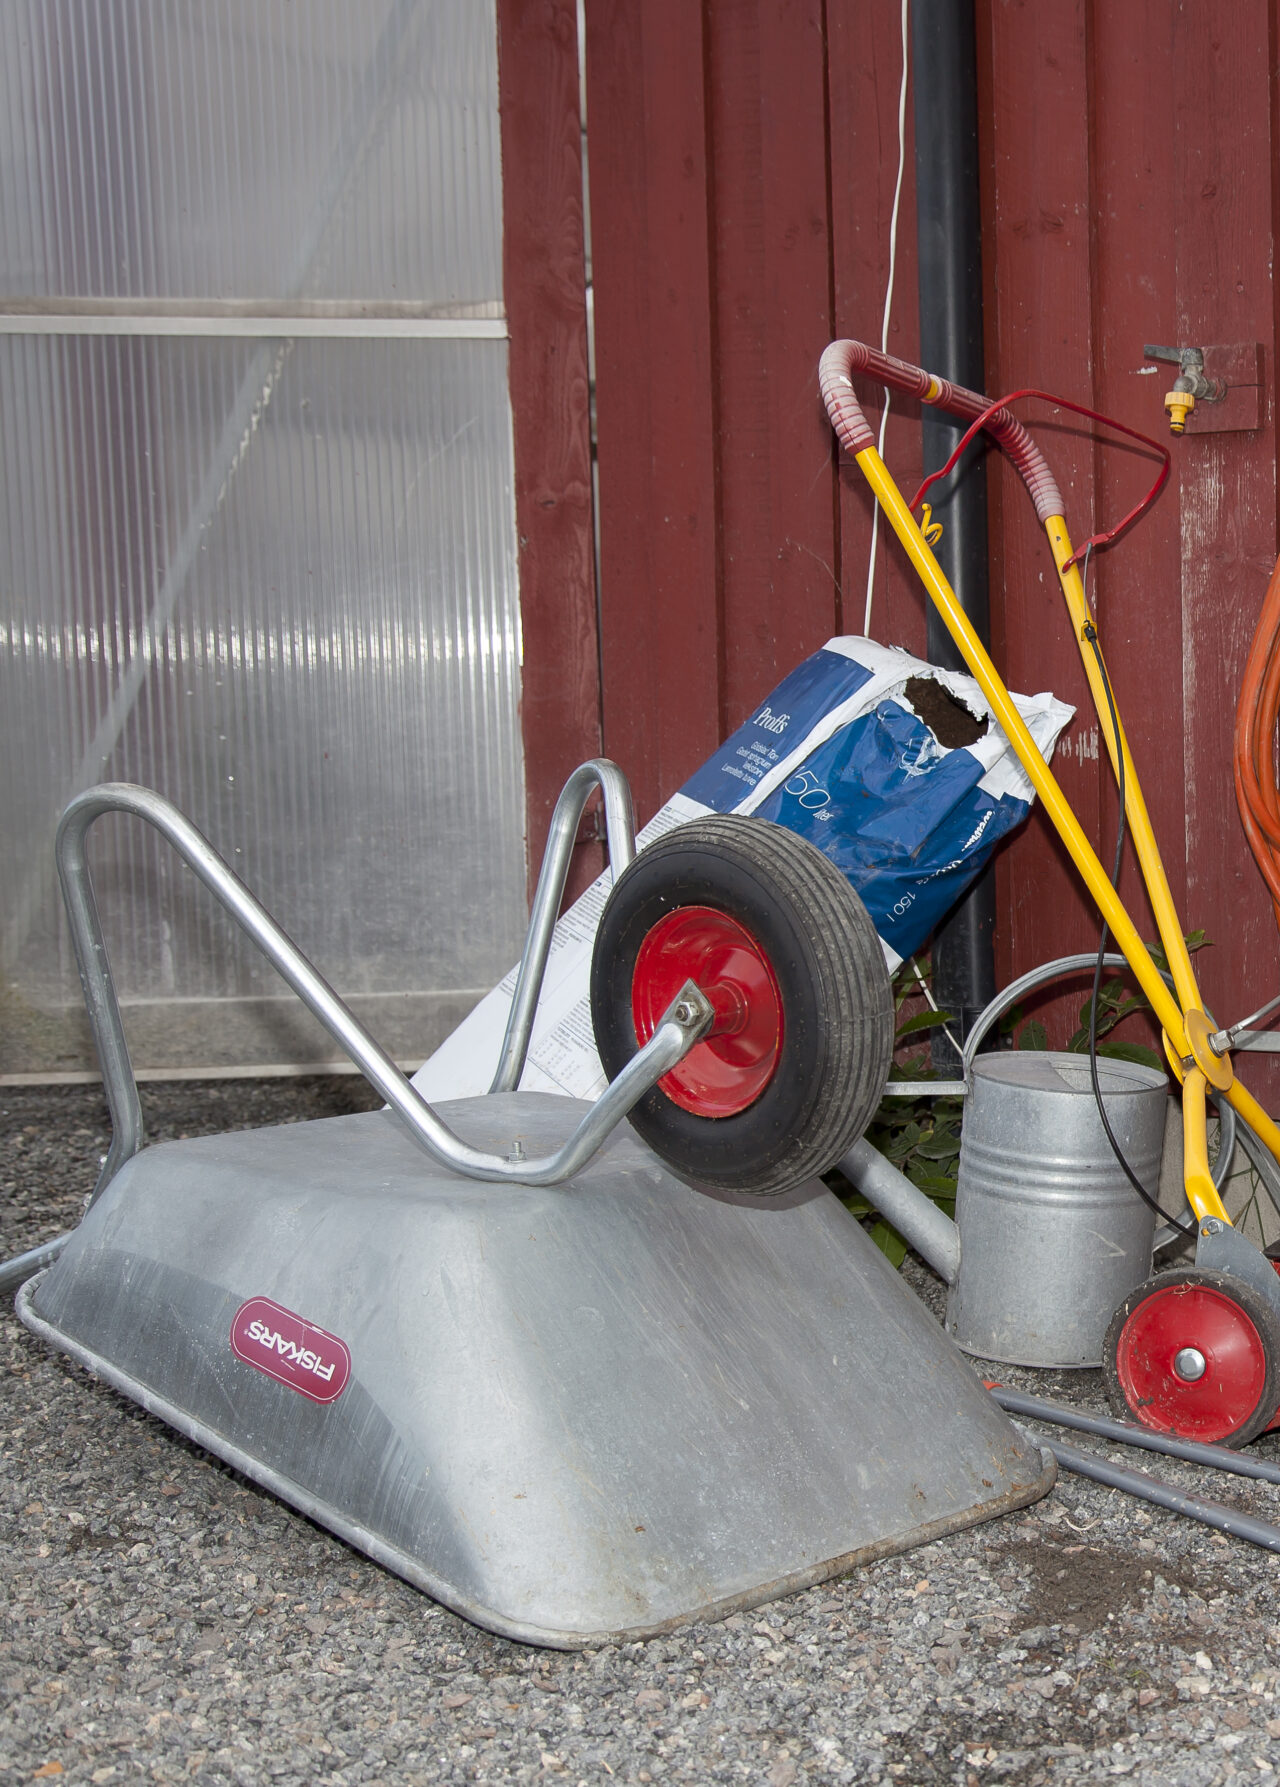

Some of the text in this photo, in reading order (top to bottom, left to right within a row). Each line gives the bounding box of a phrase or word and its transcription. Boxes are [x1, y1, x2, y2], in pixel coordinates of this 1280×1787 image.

[753, 707, 790, 734] Proffs
[893, 891, 916, 916] 150
[248, 1321, 336, 1381] FISKARS
